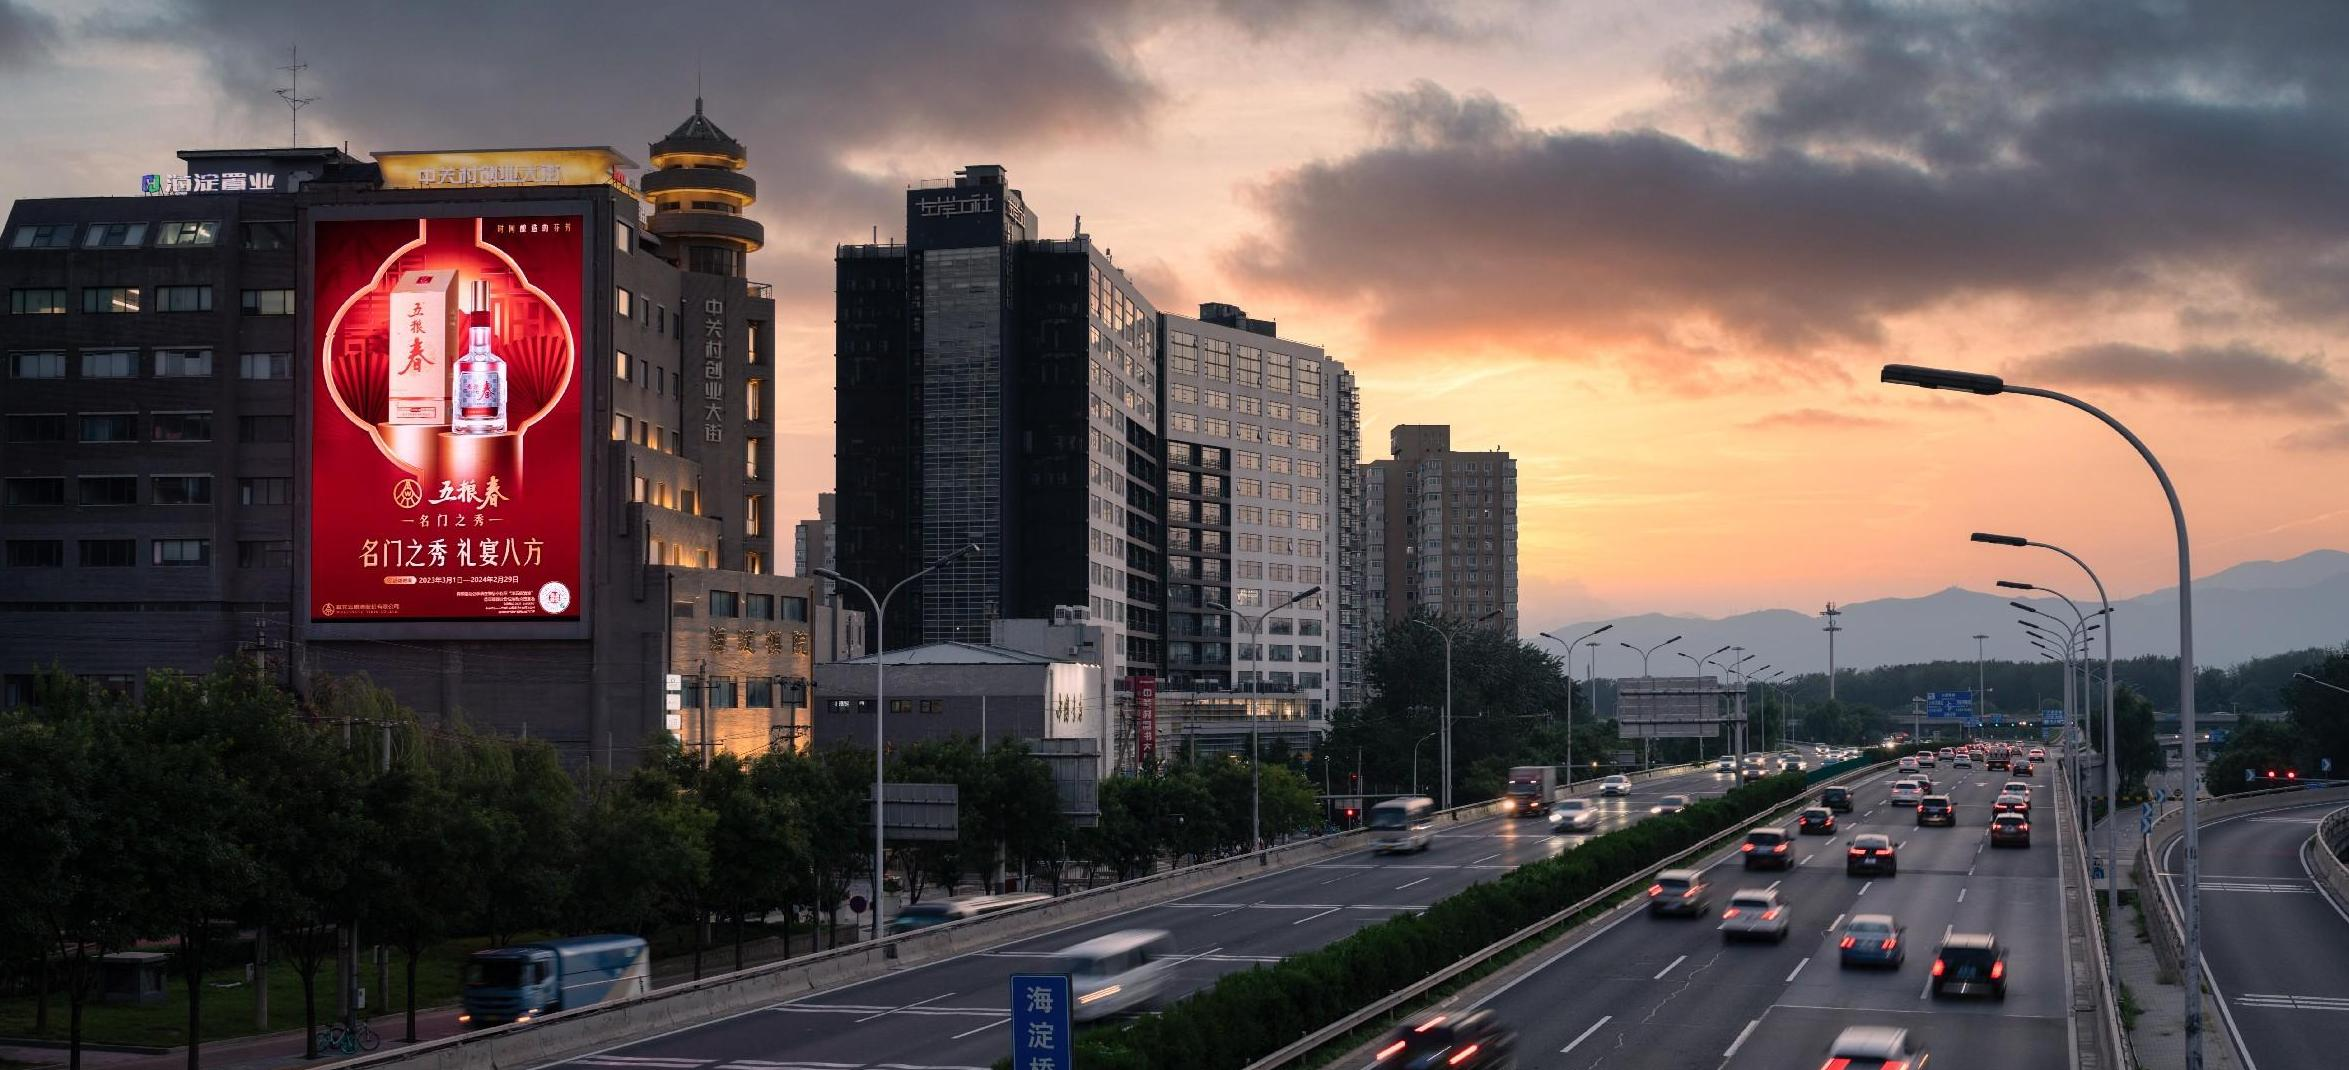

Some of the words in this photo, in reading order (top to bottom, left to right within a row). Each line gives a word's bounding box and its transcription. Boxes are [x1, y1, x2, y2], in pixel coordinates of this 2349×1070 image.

[165, 172, 276, 194] 海淀置业
[397, 302, 436, 375] 五粮春
[704, 299, 723, 443] 中关村创业大街
[428, 476, 510, 510] 五粮春
[419, 514, 485, 528] 名门之秀
[359, 538, 448, 568] 名门之秀
[456, 538, 545, 567] 礼宴八方
